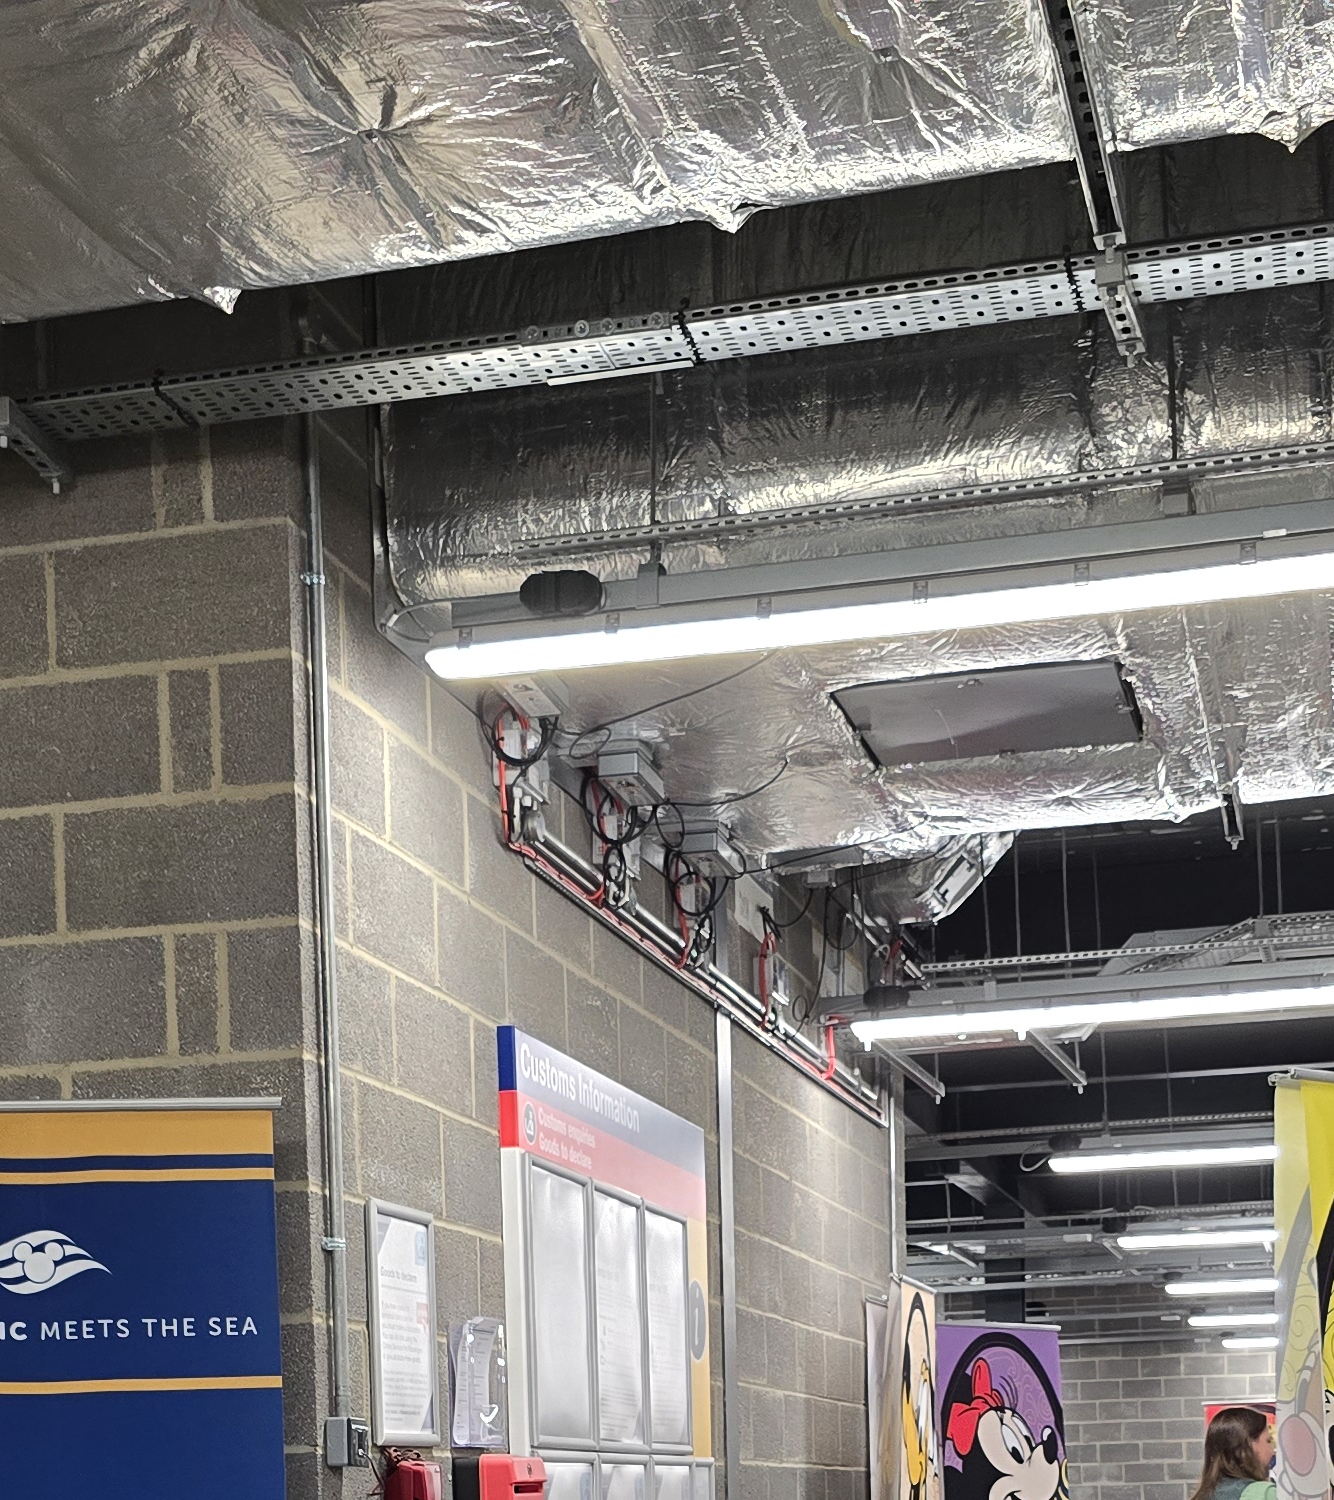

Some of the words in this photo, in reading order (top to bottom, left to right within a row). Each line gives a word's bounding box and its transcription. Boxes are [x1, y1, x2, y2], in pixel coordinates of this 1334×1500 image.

[520, 1042, 576, 1101] Customs
[578, 1073, 640, 1134] Information
[538, 1107, 567, 1135] Customs
[539, 1132, 560, 1157] Goods
[561, 1141, 569, 1161] to
[40, 1318, 130, 1341] MEETS
[142, 1318, 196, 1339] THE
[208, 1316, 259, 1337] SEA
